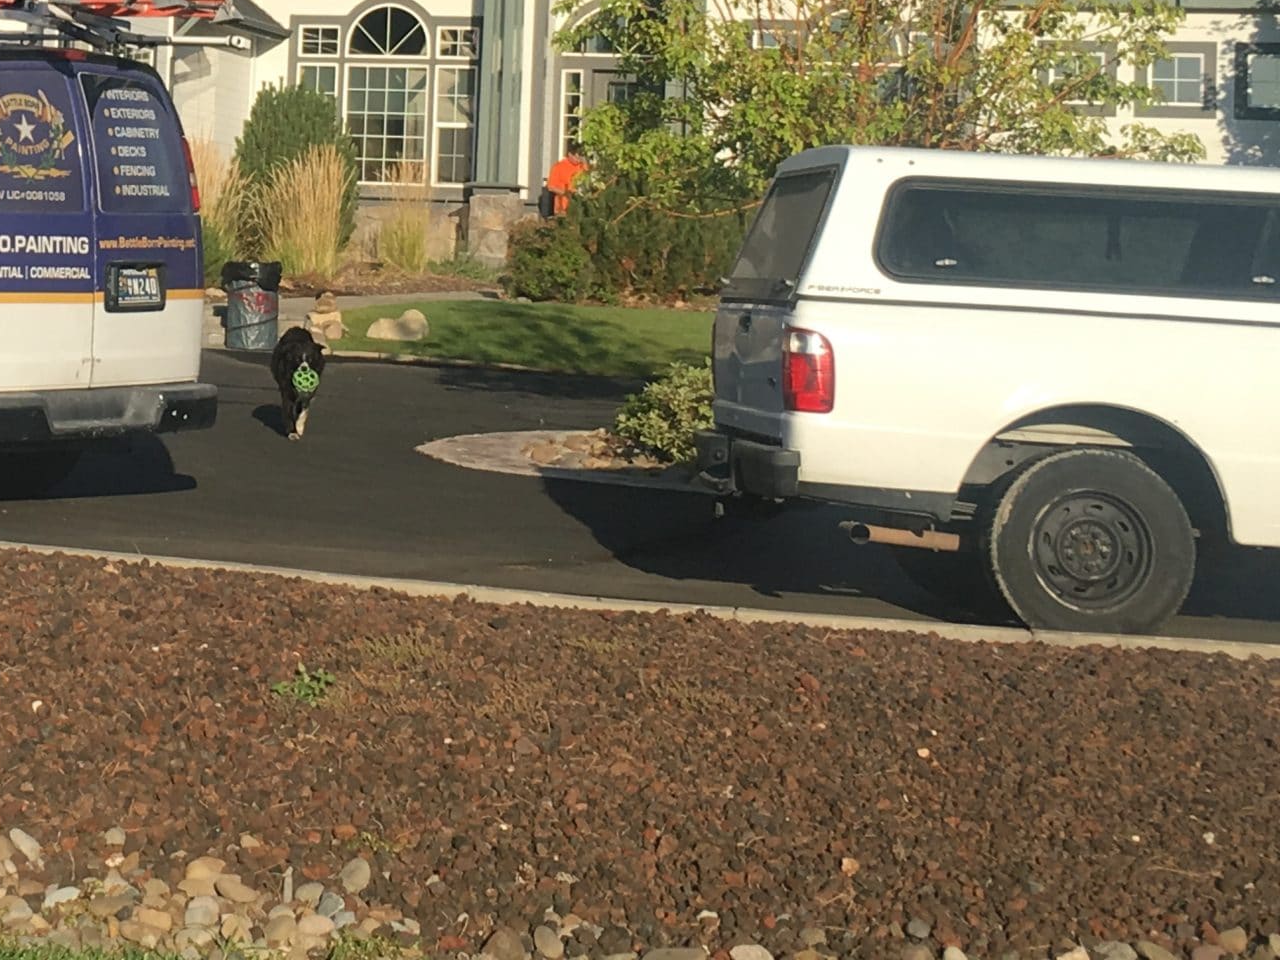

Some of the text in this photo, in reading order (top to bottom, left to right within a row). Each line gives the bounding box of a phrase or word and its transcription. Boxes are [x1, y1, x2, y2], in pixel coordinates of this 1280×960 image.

[106, 89, 150, 102] INTERIORS
[110, 107, 156, 121] EXTERIORS
[114, 126, 160, 139] CABINETRY
[4, 136, 50, 155] PAINTING
[117, 146, 147, 157] DECKS
[120, 165, 156, 177] FENCING
[121, 184, 170, 197] INDUSTRIAL
[30, 267, 91, 280] COMMERCIAL
